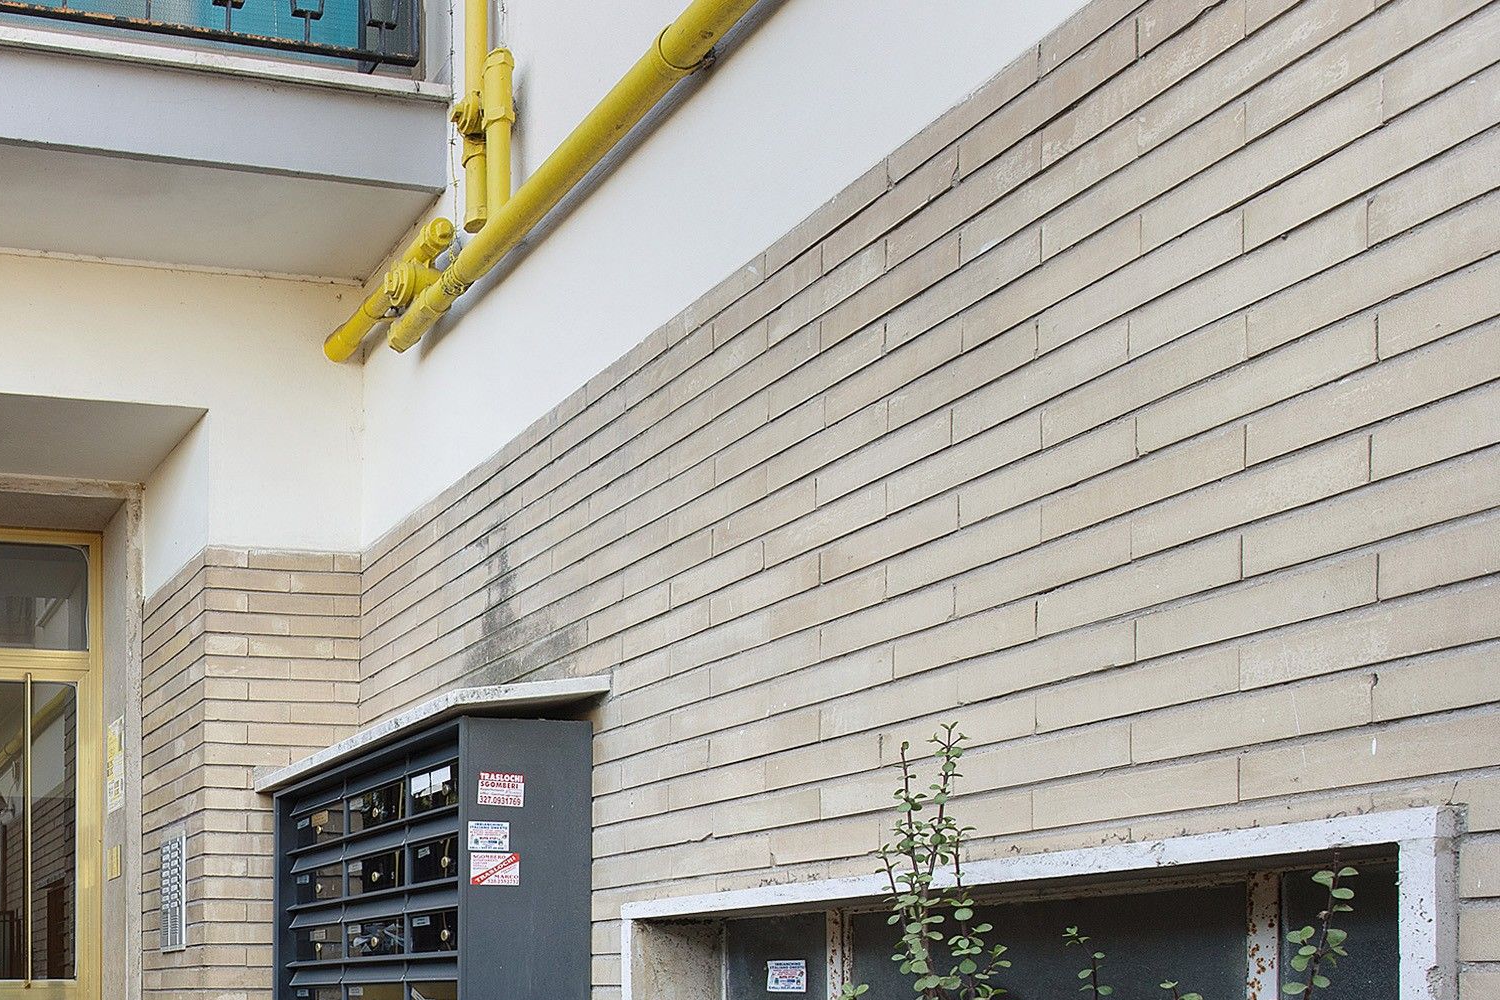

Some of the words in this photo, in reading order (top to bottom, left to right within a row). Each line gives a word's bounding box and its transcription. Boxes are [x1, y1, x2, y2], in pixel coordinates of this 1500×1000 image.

[480, 772, 523, 783] TRASLOCHI
[480, 781, 519, 789] SGOMBERI
[474, 855, 517, 883] TRASLOCHI
